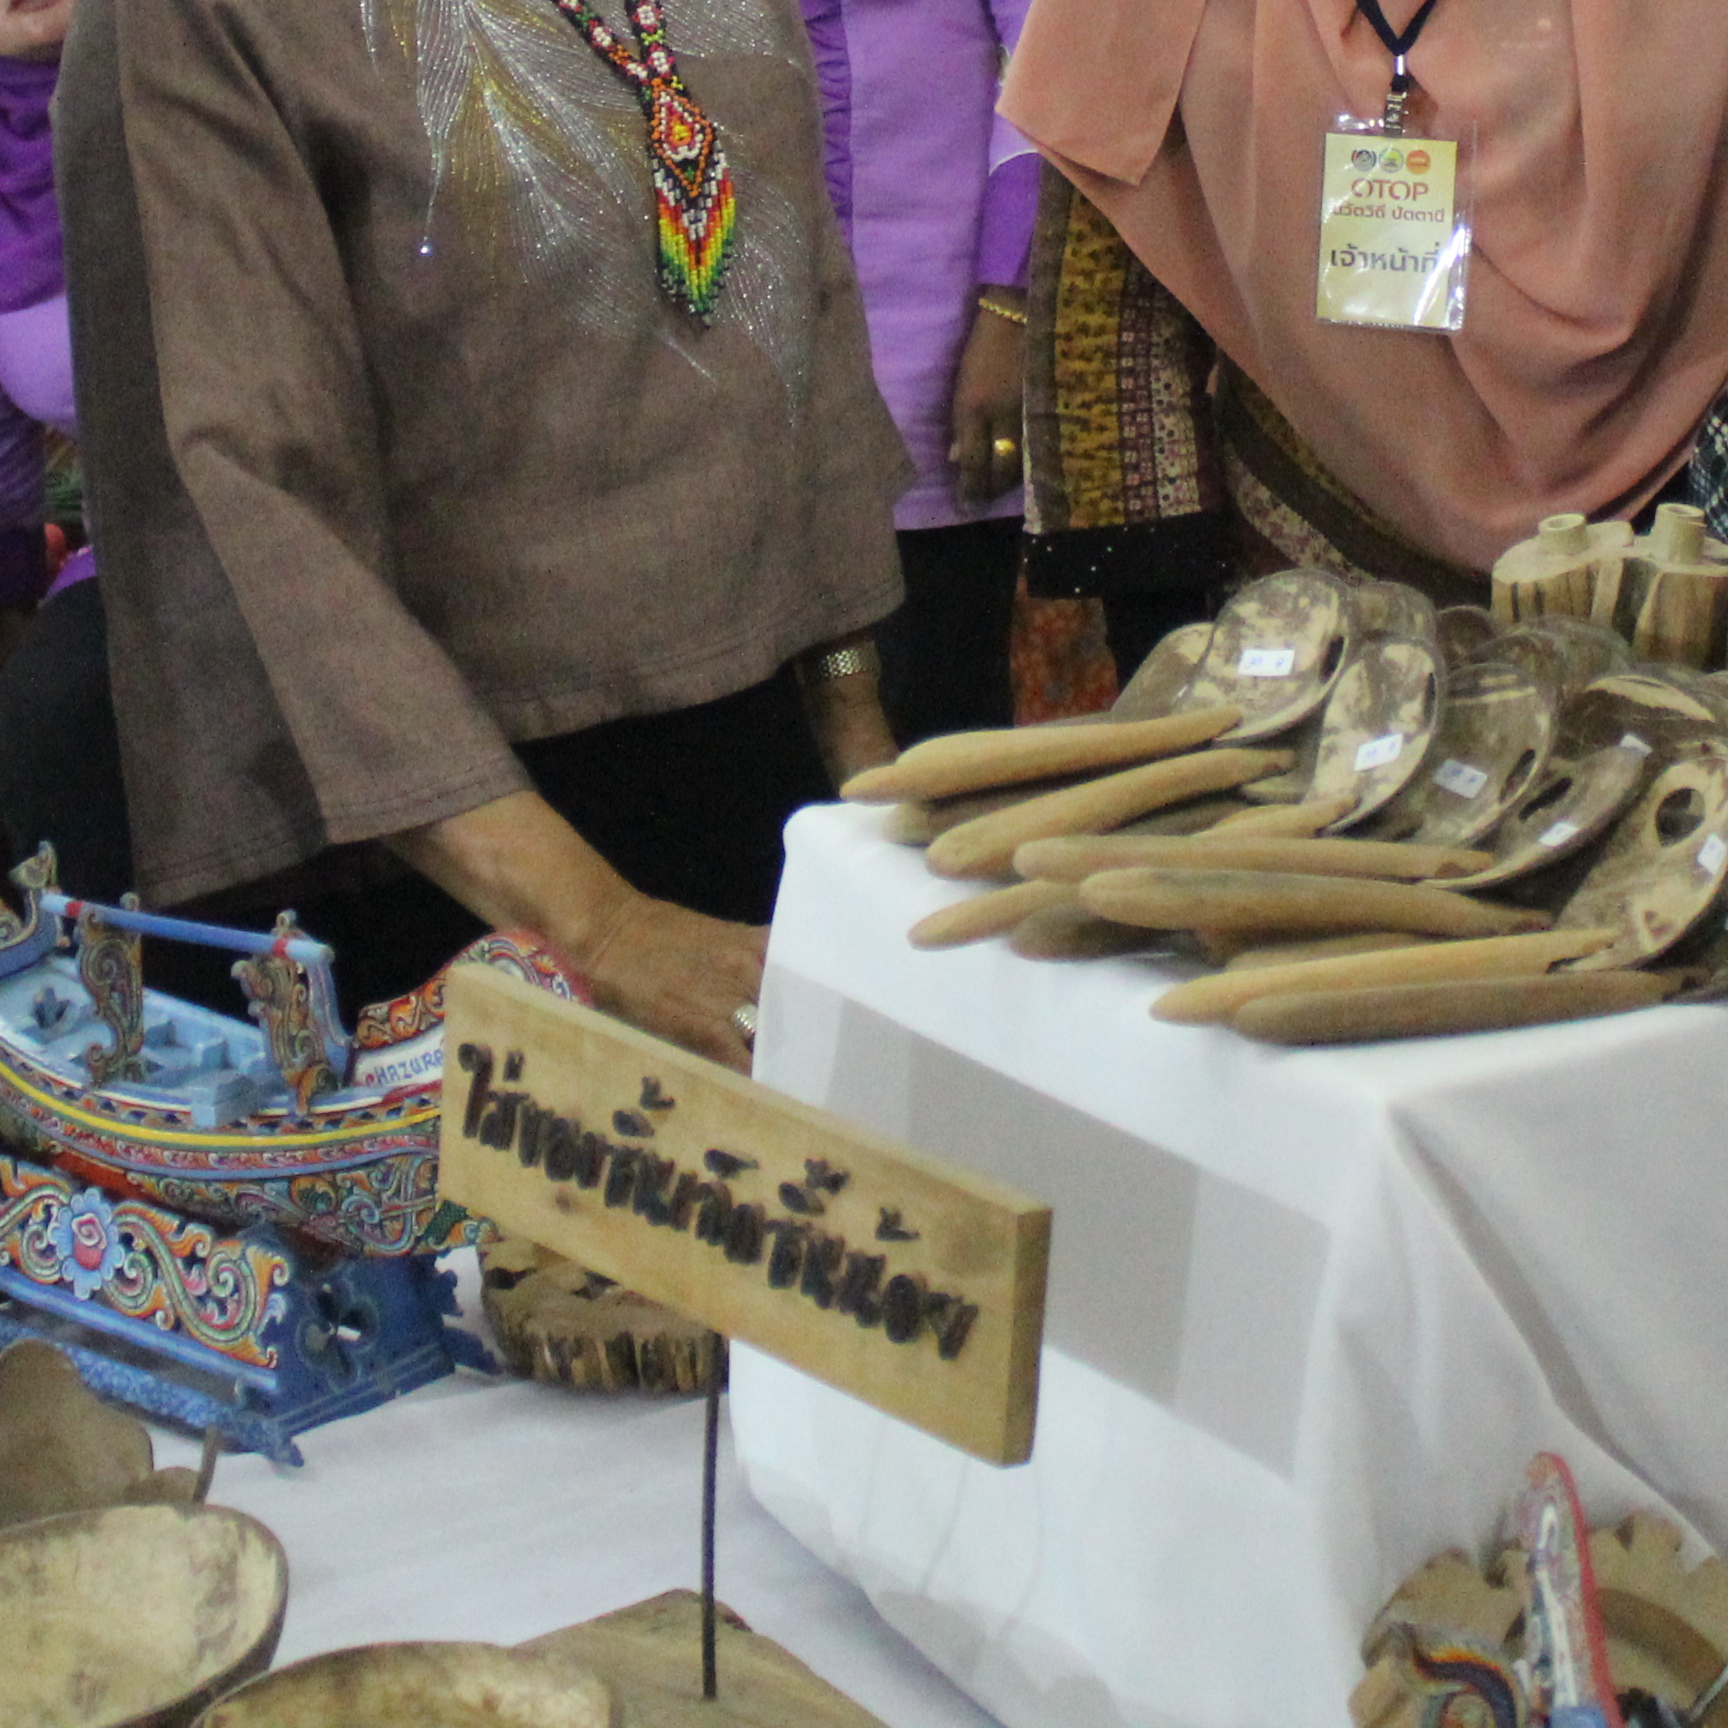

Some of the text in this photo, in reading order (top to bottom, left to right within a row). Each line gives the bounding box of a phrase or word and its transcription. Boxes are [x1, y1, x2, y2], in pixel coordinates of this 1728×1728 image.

[1351, 178, 1429, 202] OTOP
[1392, 204, 1445, 223] ปัตตานี
[1330, 242, 1442, 273] เจ้าหน้าที่
